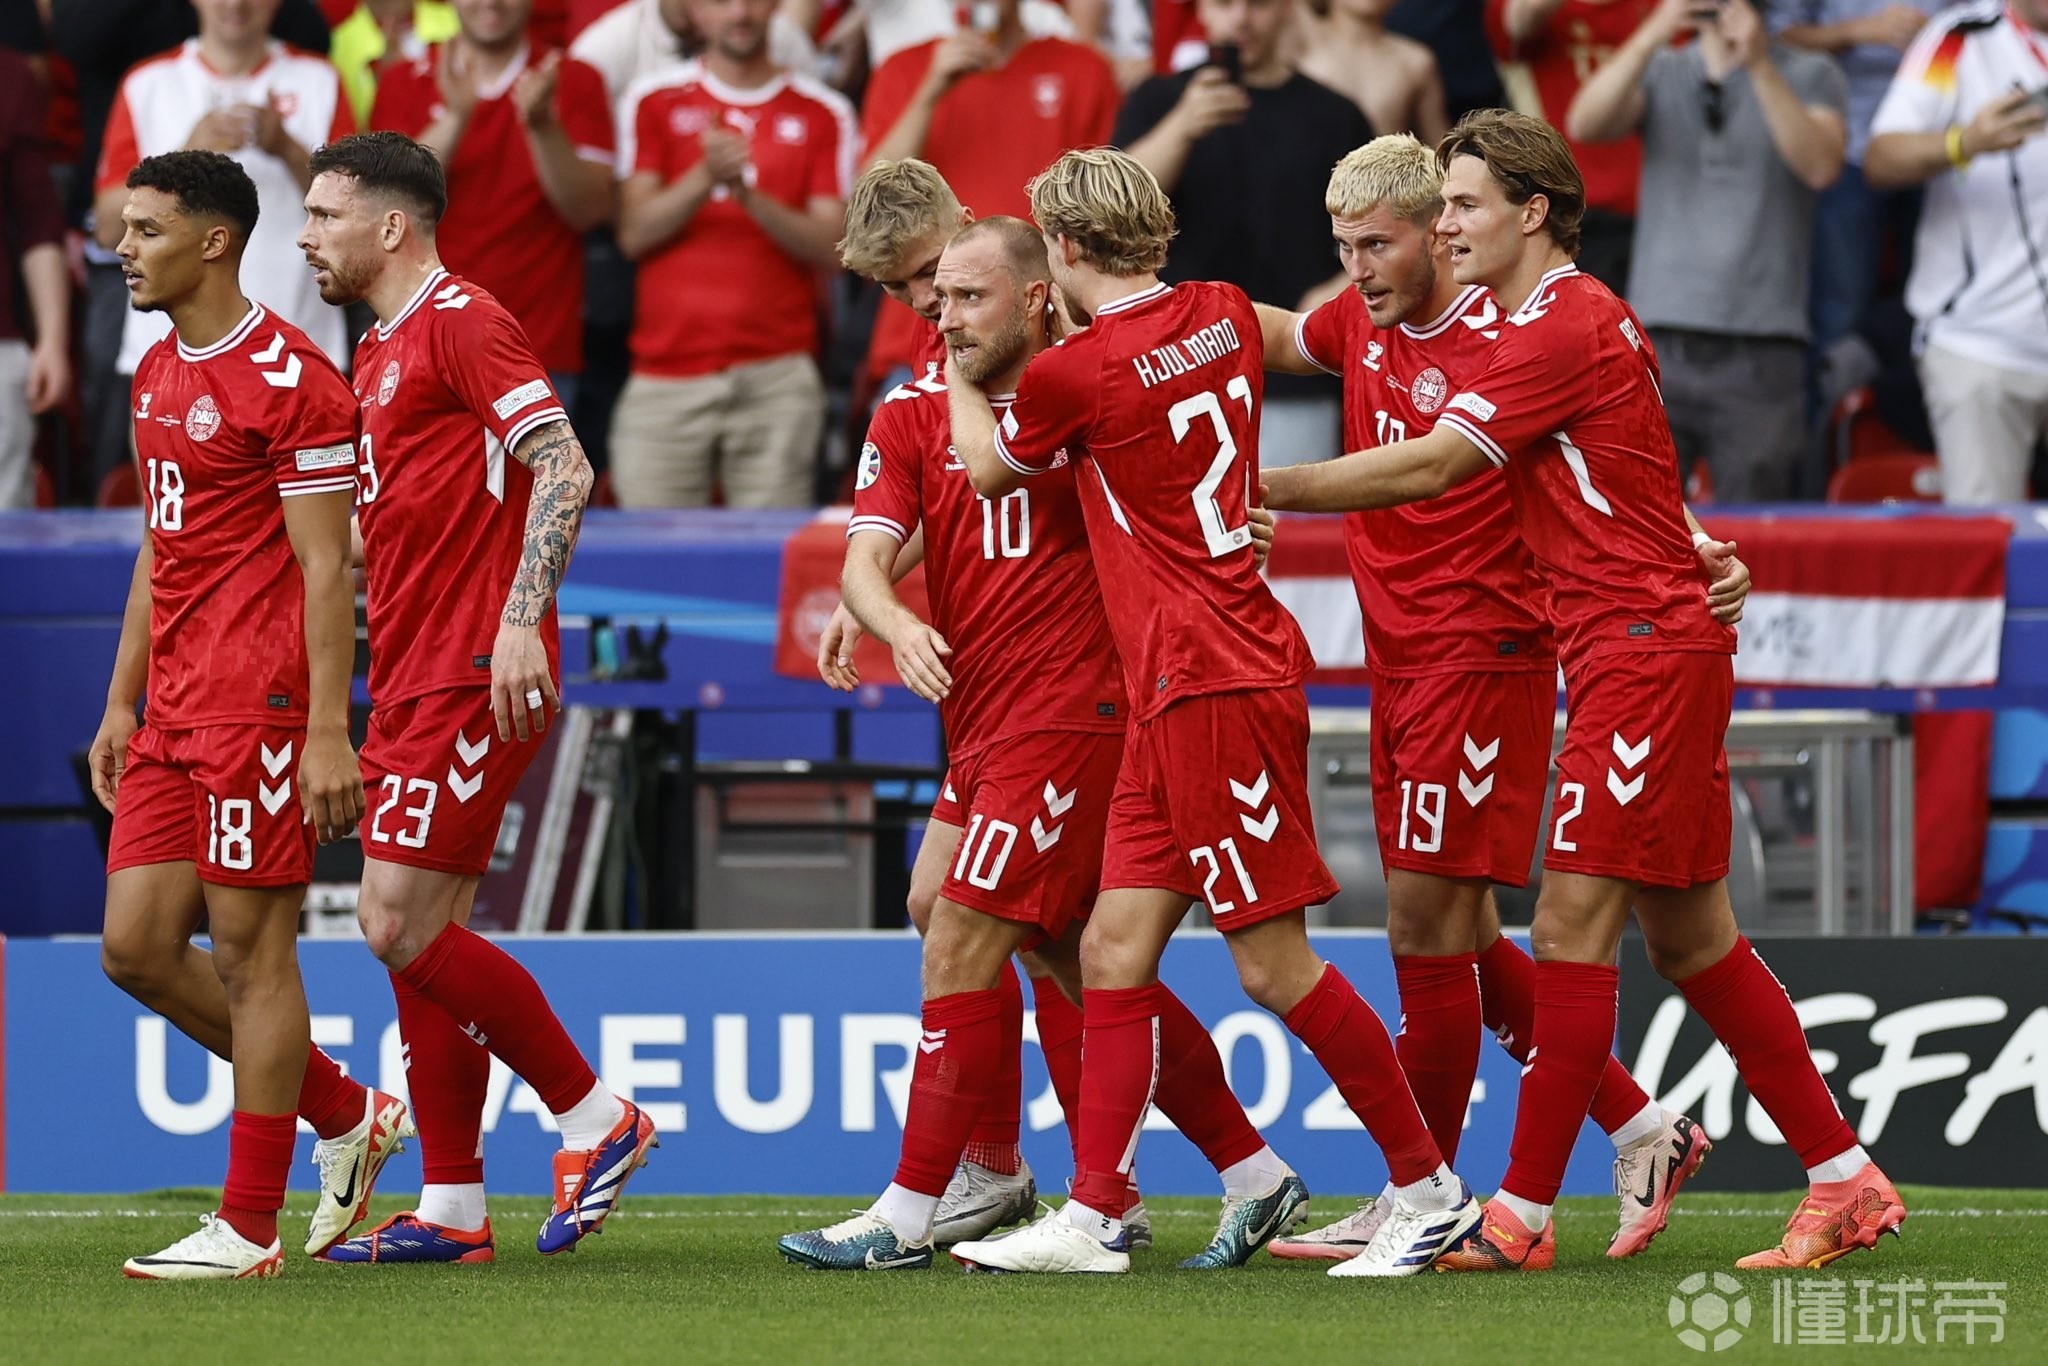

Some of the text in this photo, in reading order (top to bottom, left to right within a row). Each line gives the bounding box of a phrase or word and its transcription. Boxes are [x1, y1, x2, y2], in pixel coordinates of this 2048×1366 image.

[1132, 317, 1241, 389] HJULMAND
[497, 386, 547, 412] FOUNDATION
[297, 450, 354, 463] FOUNDATION
[355, 433, 379, 505] 3
[147, 458, 185, 531] 18
[976, 487, 1030, 560] 10
[208, 794, 253, 870] 18
[371, 774, 438, 849] 23
[1398, 780, 1447, 853] 19
[1553, 782, 1585, 852] 2
[953, 813, 1019, 891] 10
[1189, 837, 1258, 915] 21
[135, 1014, 562, 1134] UA
[1142, 1009, 1486, 1131] 02
